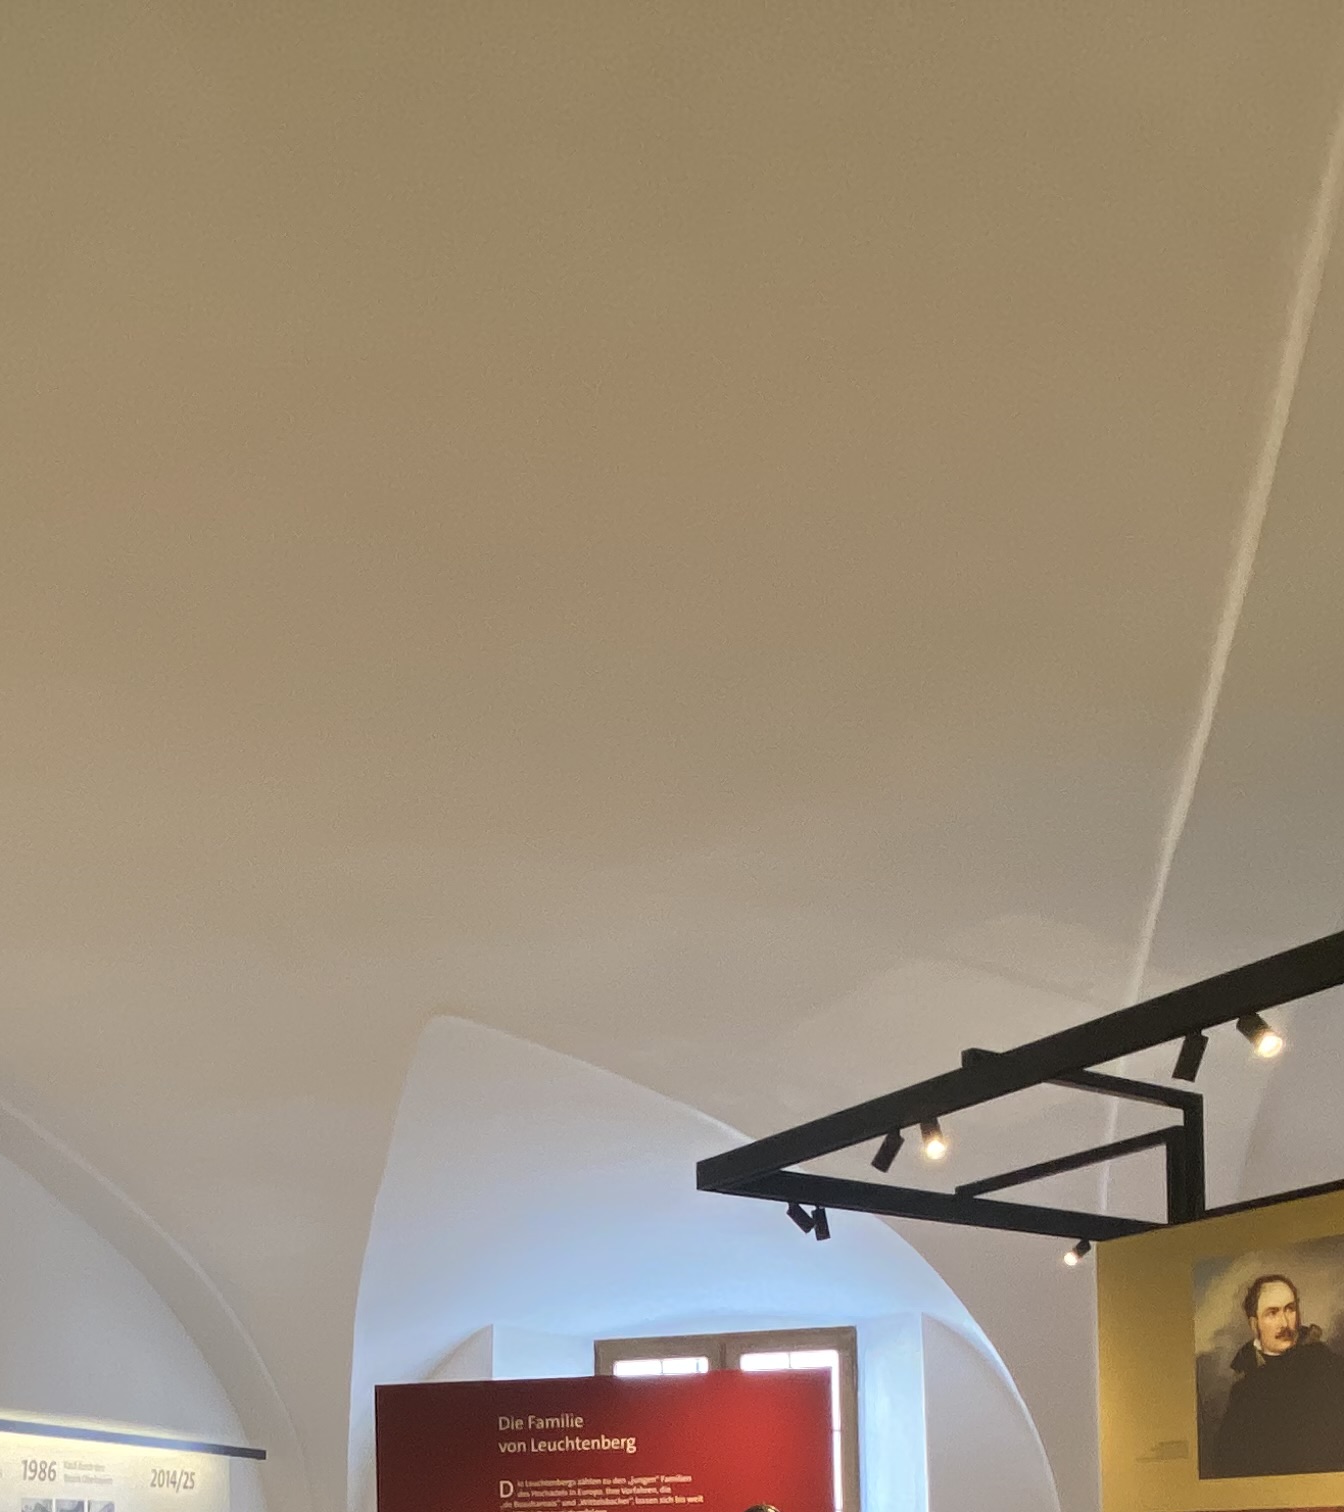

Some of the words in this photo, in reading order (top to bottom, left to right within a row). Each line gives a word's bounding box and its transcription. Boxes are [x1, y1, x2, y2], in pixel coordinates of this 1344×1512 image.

[498, 1416, 524, 1431] Die
[528, 1413, 584, 1430] Familie
[498, 1440, 527, 1454] von
[530, 1435, 637, 1454] Leuchtenberg
[21, 1458, 57, 1482] 1986
[149, 1468, 196, 1493] 2014/25
